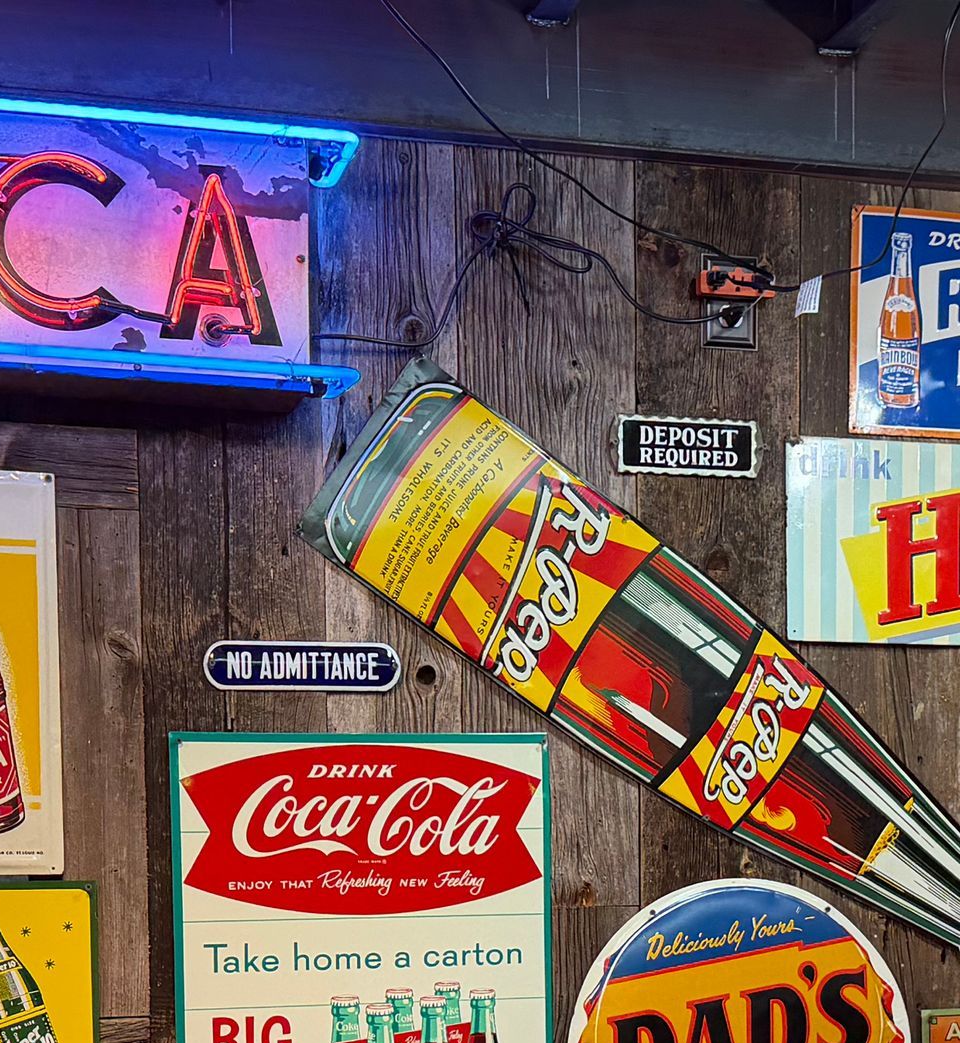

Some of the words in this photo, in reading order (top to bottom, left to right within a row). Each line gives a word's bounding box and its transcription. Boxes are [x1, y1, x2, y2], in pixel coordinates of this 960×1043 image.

[474, 417, 492, 435] ACID
[481, 423, 500, 442] FROM
[640, 426, 739, 448] DEPOSIT
[432, 437, 452, 458] IT'S
[460, 432, 477, 450] AND
[464, 440, 484, 461] OTHER
[476, 429, 510, 464] CONTAINS
[492, 457, 504, 470] A
[640, 447, 738, 467] REQUIRED
[799, 450, 892, 480] drink
[444, 460, 467, 486] FRUITS
[454, 463, 478, 489] PRUNE
[387, 461, 432, 523] WHOLESOME
[433, 485, 447, 501] AND
[437, 488, 458, 513] JUICE
[453, 466, 497, 521] Carbonated
[404, 503, 422, 528] MORE
[426, 511, 443, 530] AND
[392, 527, 408, 548] THAN
[400, 533, 416, 554] CANE
[415, 529, 431, 549] TRUE
[424, 516, 461, 565] Beverage
[406, 546, 421, 567] FRUIT
[501, 536, 519, 570] MAKE
[378, 552, 395, 578] DRINK
[496, 576, 505, 588] IT
[474, 593, 498, 636] YOURS
[226, 651, 253, 680] NO
[259, 651, 380, 681] ADMITTANCE
[748, 672, 761, 696] MAKE
[307, 764, 397, 779] DRINK
[232, 774, 508, 858] Coca-Cola
[228, 880, 273, 891] ENJOY
[280, 878, 313, 890] THAT
[317, 869, 393, 896] Refreshing
[400, 877, 428, 888] NEW
[434, 870, 486, 895] Feeling
[646, 920, 744, 961] Deliciously
[751, 914, 803, 942] Yours
[8, 961, 17, 969] 10
[203, 943, 280, 973] Take
[293, 942, 382, 971] home
[395, 951, 411, 968] a
[423, 943, 522, 967] carton
[335, 1021, 358, 1032] Coke
